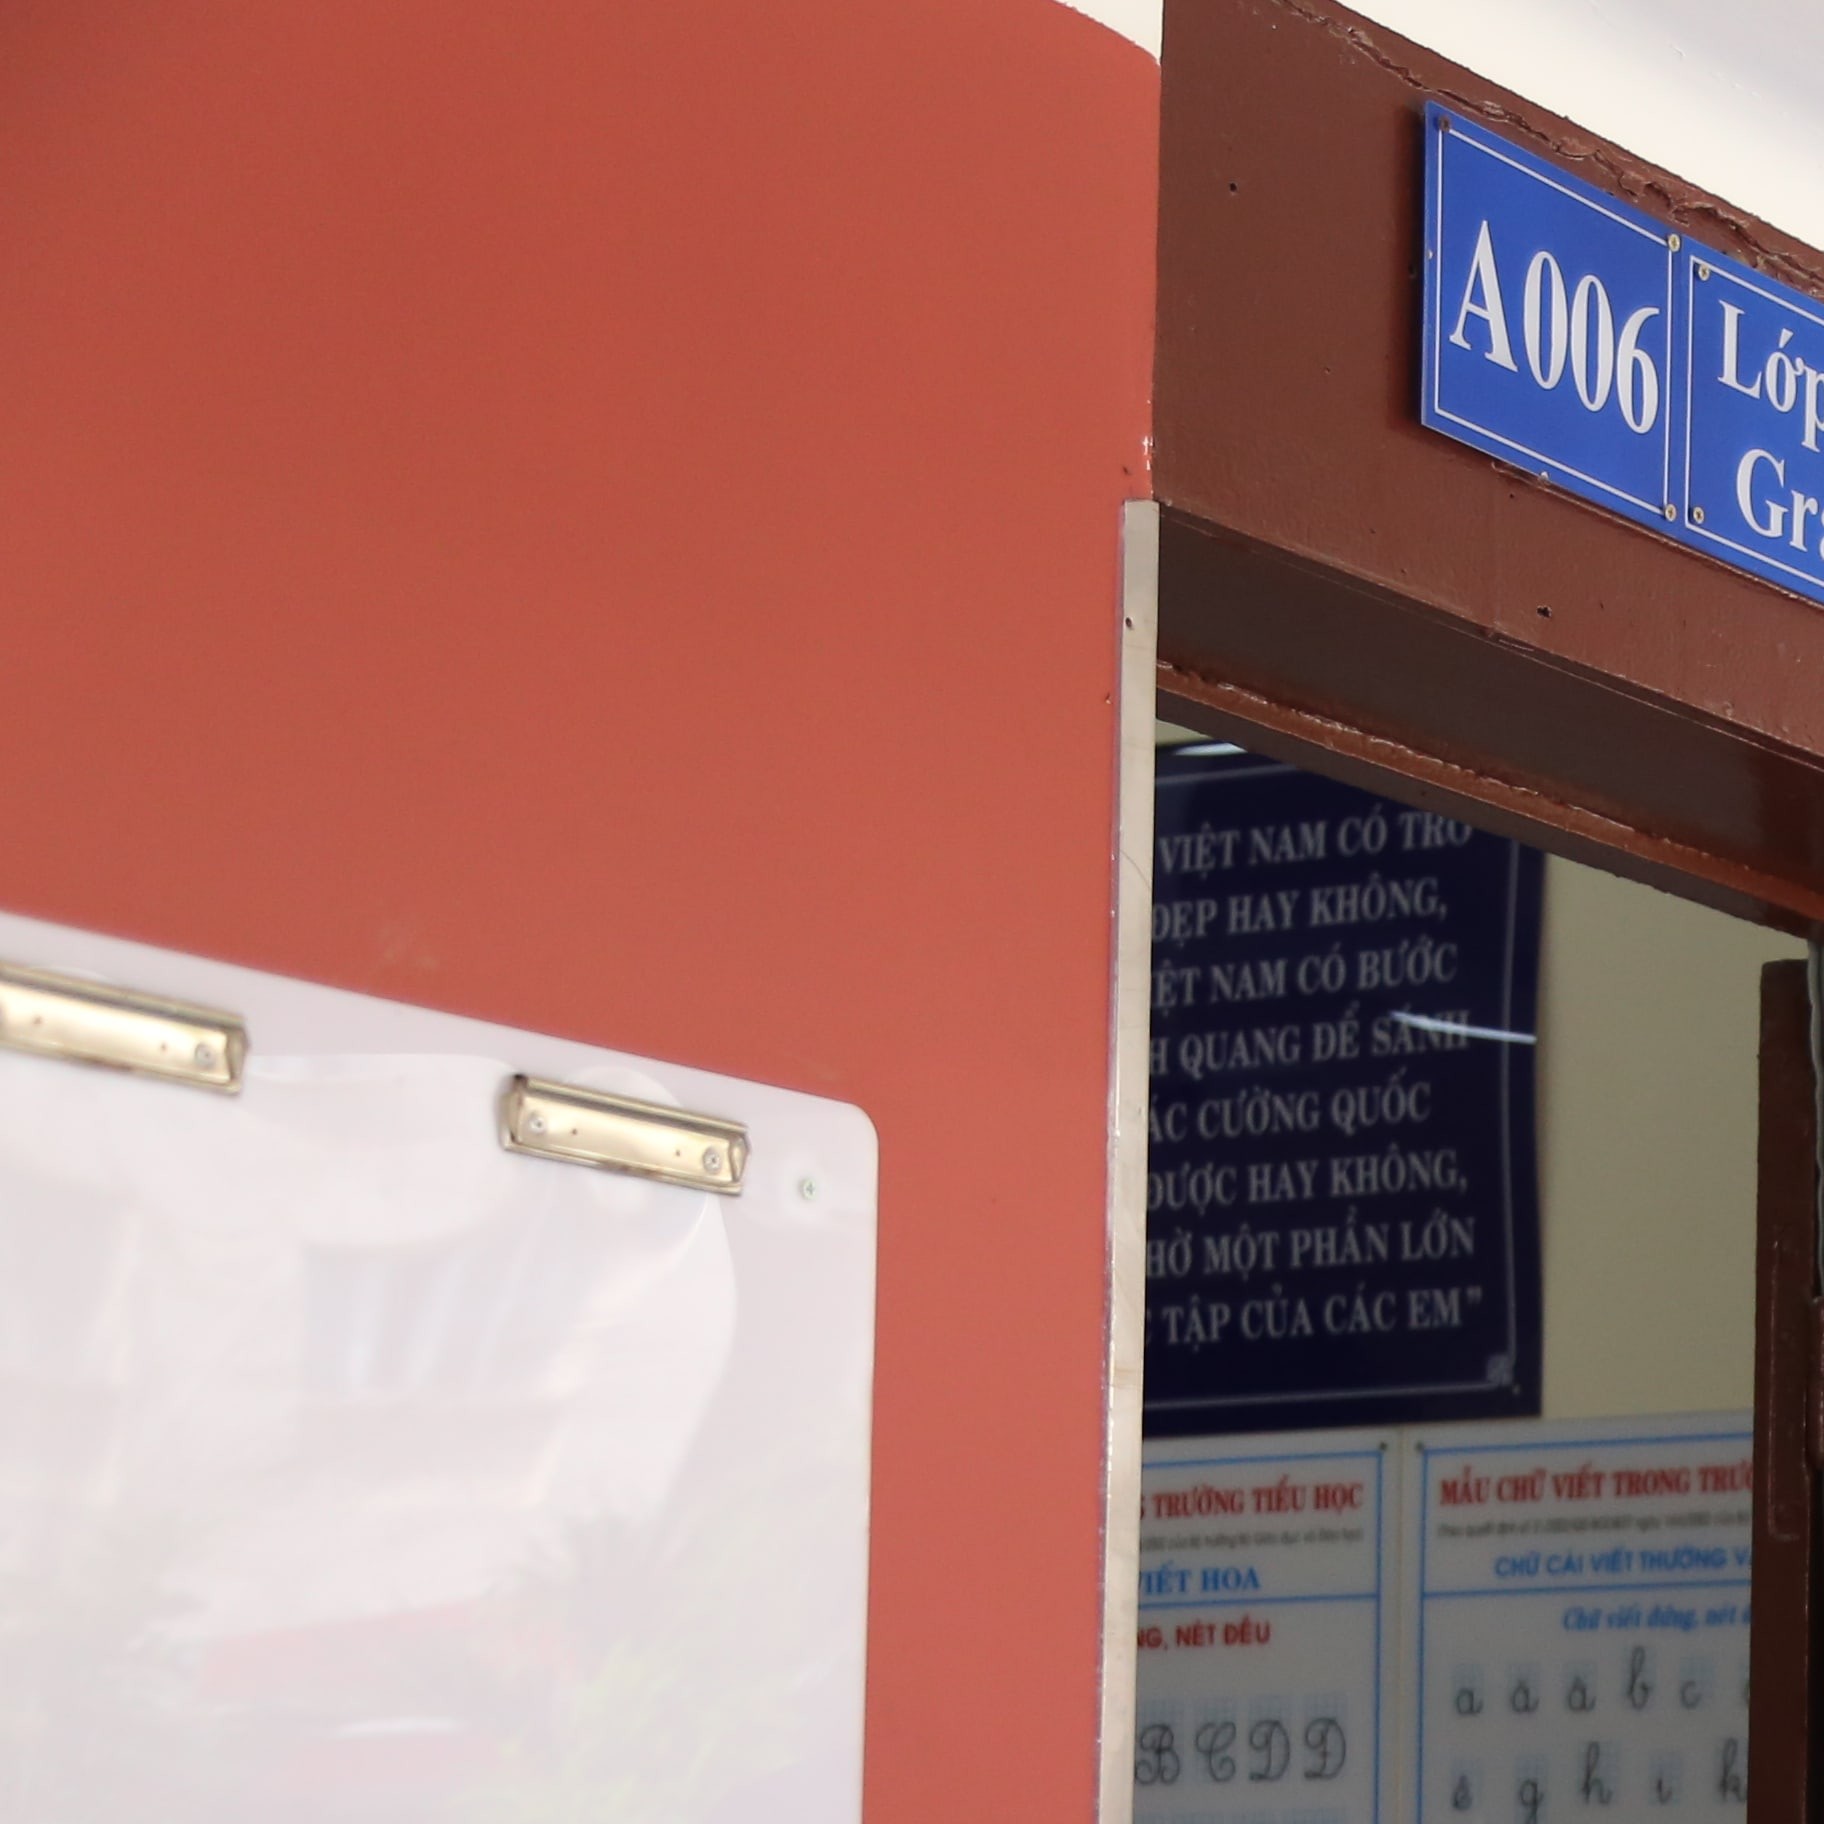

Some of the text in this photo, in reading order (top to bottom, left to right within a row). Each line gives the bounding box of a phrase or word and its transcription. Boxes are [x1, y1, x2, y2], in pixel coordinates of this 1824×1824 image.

[1449, 219, 1660, 434] A006
[1159, 822, 1240, 879] VIỆT
[1250, 823, 1326, 864] NAM
[1337, 803, 1388, 857] CÓ
[1228, 890, 1299, 934] HAY
[1309, 872, 1447, 927] KHÔNG,
[1210, 959, 1287, 1002] NAM
[1300, 942, 1346, 996] CÓ
[1358, 934, 1458, 991] BƯỚC
[1179, 1024, 1300, 1080] QUANG
[1197, 1084, 1320, 1139] CƯỜNG
[1330, 1067, 1432, 1136] QUỐC
[1248, 1160, 1318, 1200] HAY
[1330, 1144, 1468, 1197] KHÔNG,
[1203, 1225, 1279, 1280] MỘT
[1402, 1209, 1476, 1262] LỚN
[1162, 1296, 1231, 1352] TẬP
[1241, 1285, 1314, 1339] CỦA
[1324, 1283, 1396, 1334] CÁC
[1314, 1482, 1363, 1516] HỌC
[1611, 1467, 1690, 1498] TRONG
[1202, 1566, 1260, 1592] HOA
